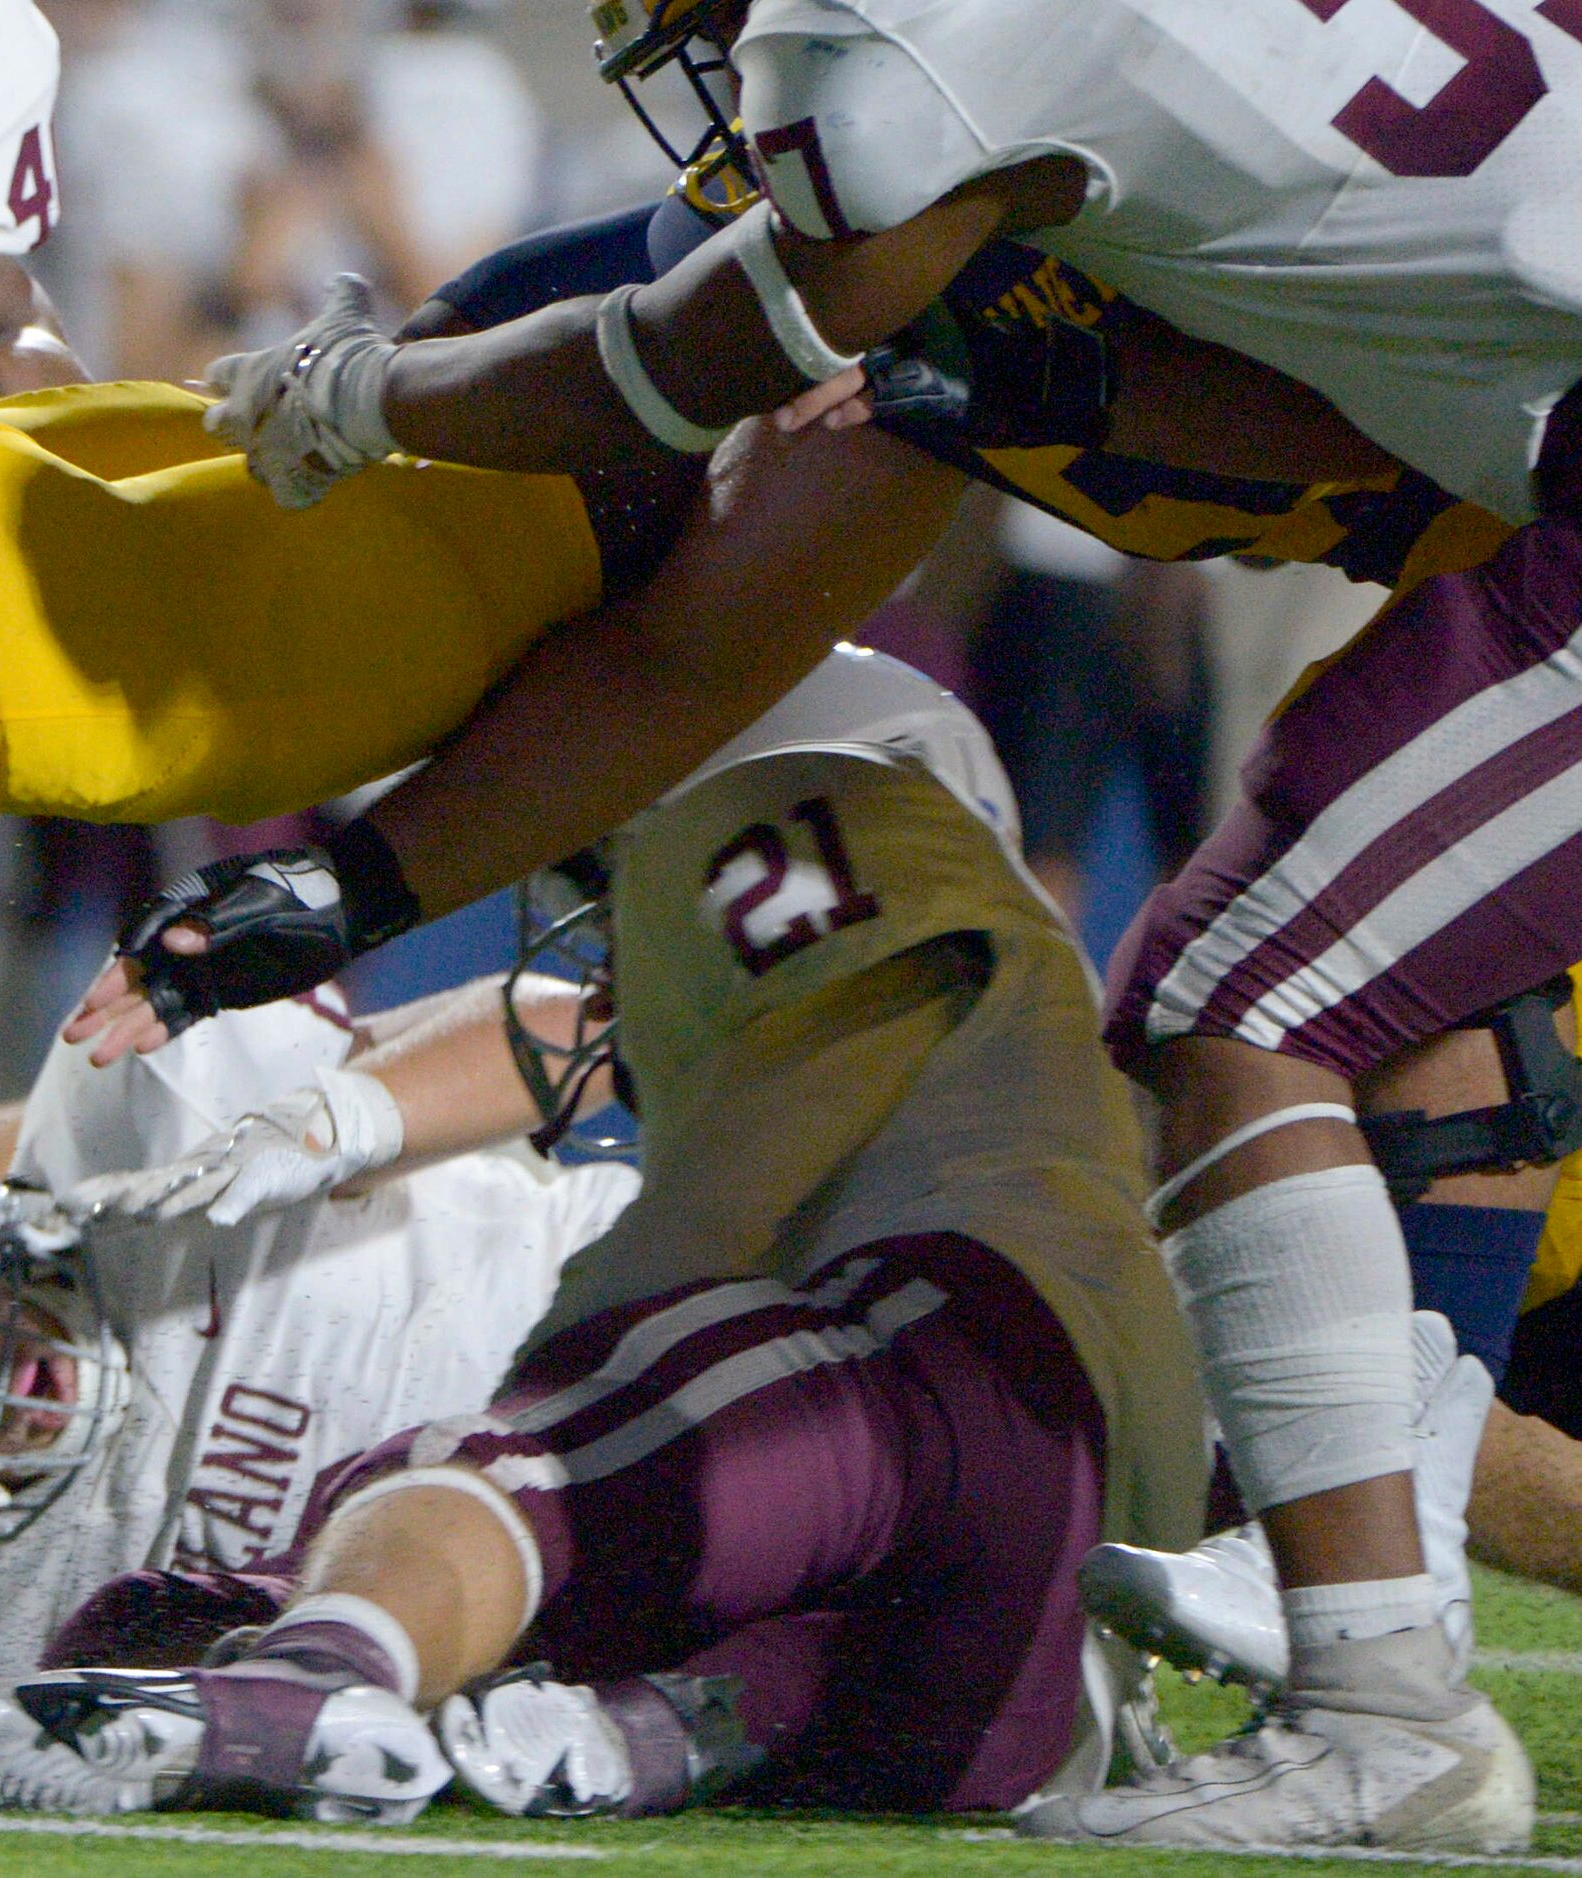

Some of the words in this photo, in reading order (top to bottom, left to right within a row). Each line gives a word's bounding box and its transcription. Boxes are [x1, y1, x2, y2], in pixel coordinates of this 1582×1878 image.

[8, 124, 52, 252] 4
[703, 797, 883, 979] 21
[170, 1383, 311, 1575] LANO
